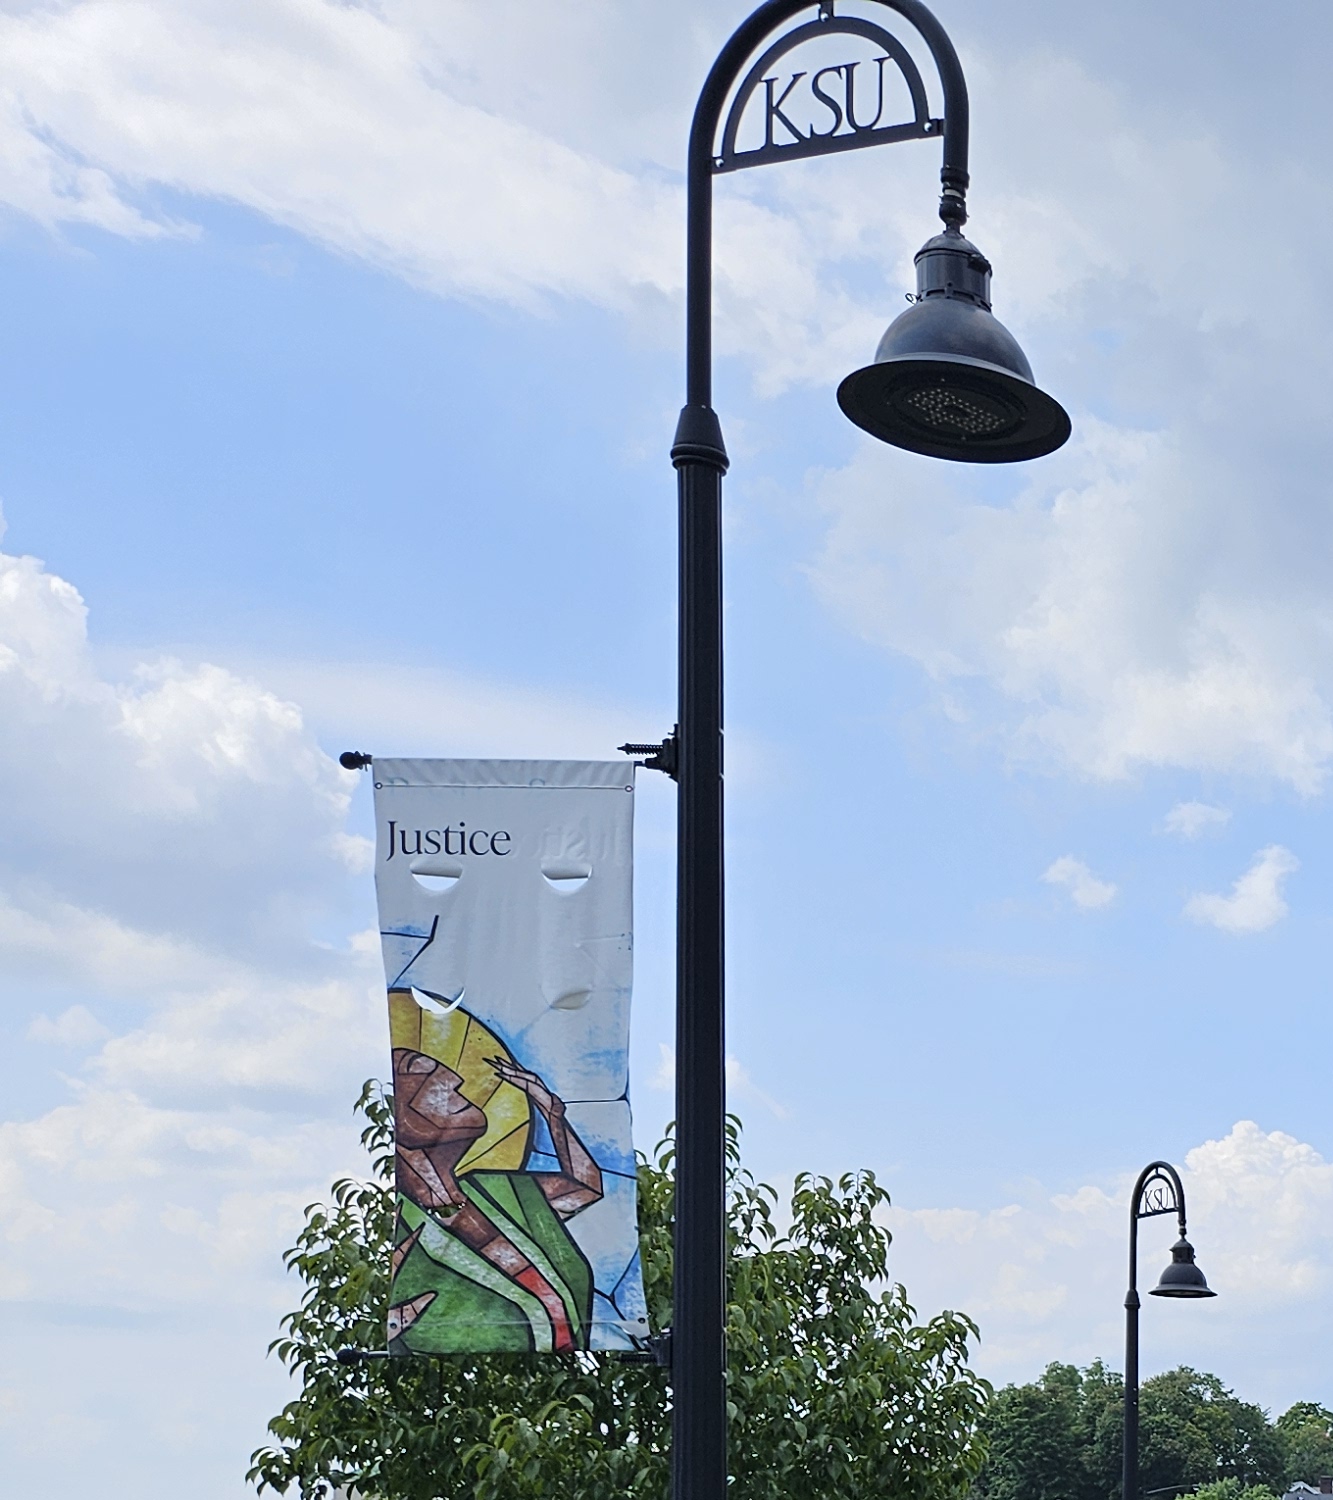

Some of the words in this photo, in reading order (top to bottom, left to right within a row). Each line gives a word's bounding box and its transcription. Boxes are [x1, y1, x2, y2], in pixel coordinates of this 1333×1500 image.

[760, 56, 890, 148] KSU
[386, 820, 511, 861] Justice
[1143, 1187, 1169, 1214] KSU
